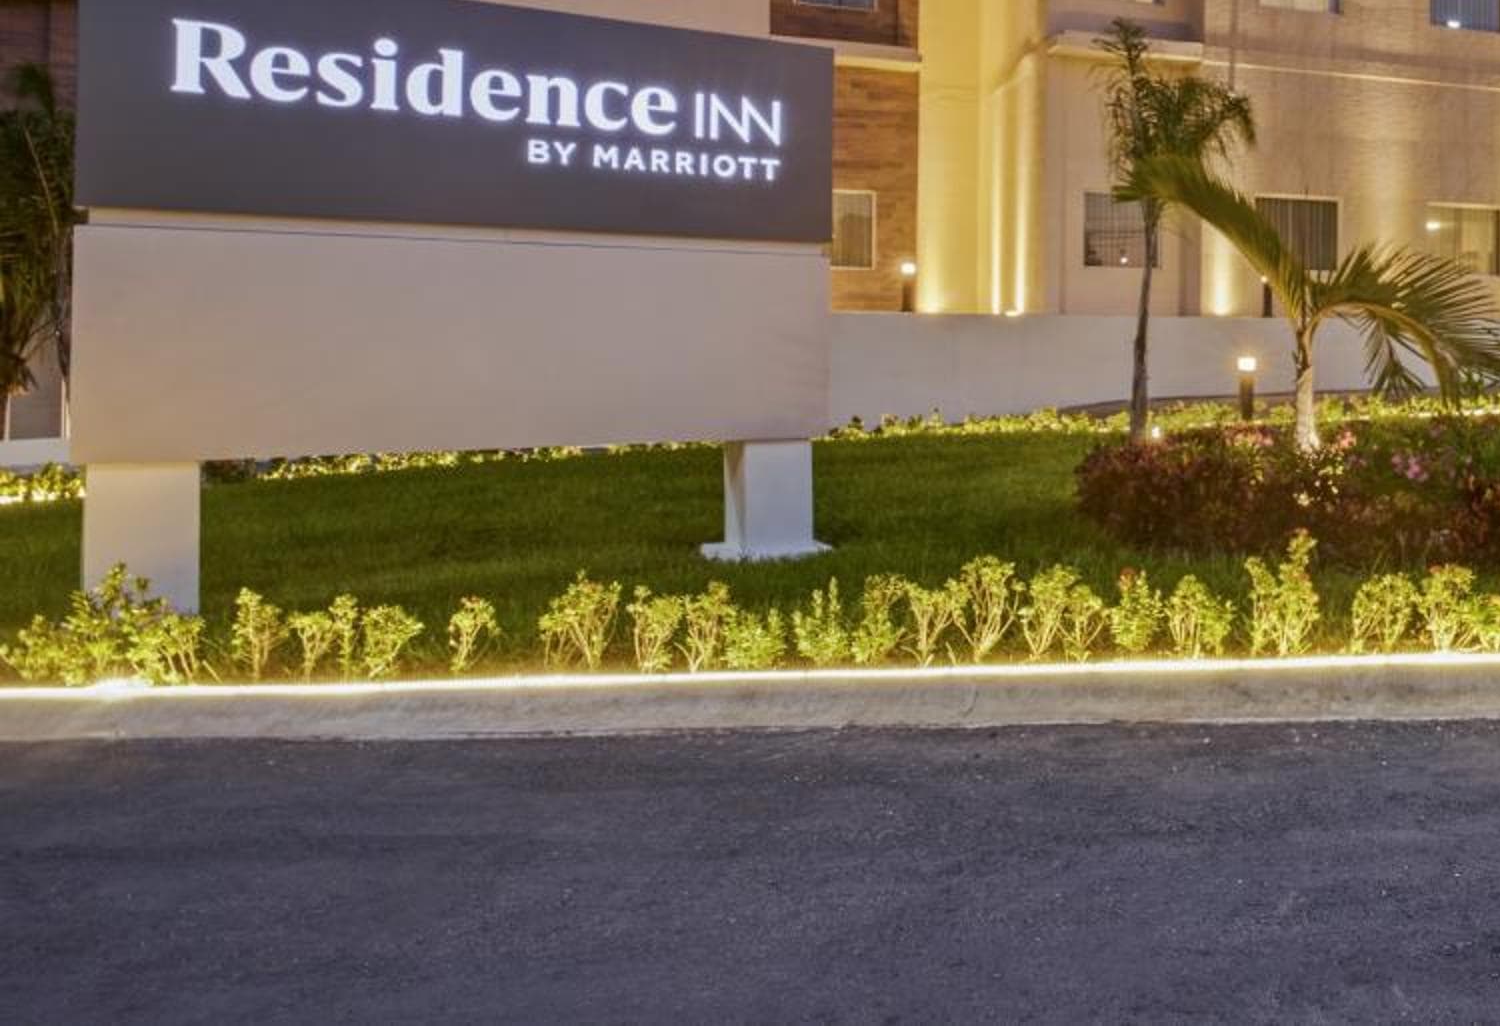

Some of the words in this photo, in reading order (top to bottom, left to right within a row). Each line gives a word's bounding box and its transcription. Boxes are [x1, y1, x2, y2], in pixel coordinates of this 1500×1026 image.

[169, 17, 678, 136] Residence
[693, 90, 783, 147] INN
[526, 137, 577, 166] BY
[592, 143, 781, 182] MARRIOTT
